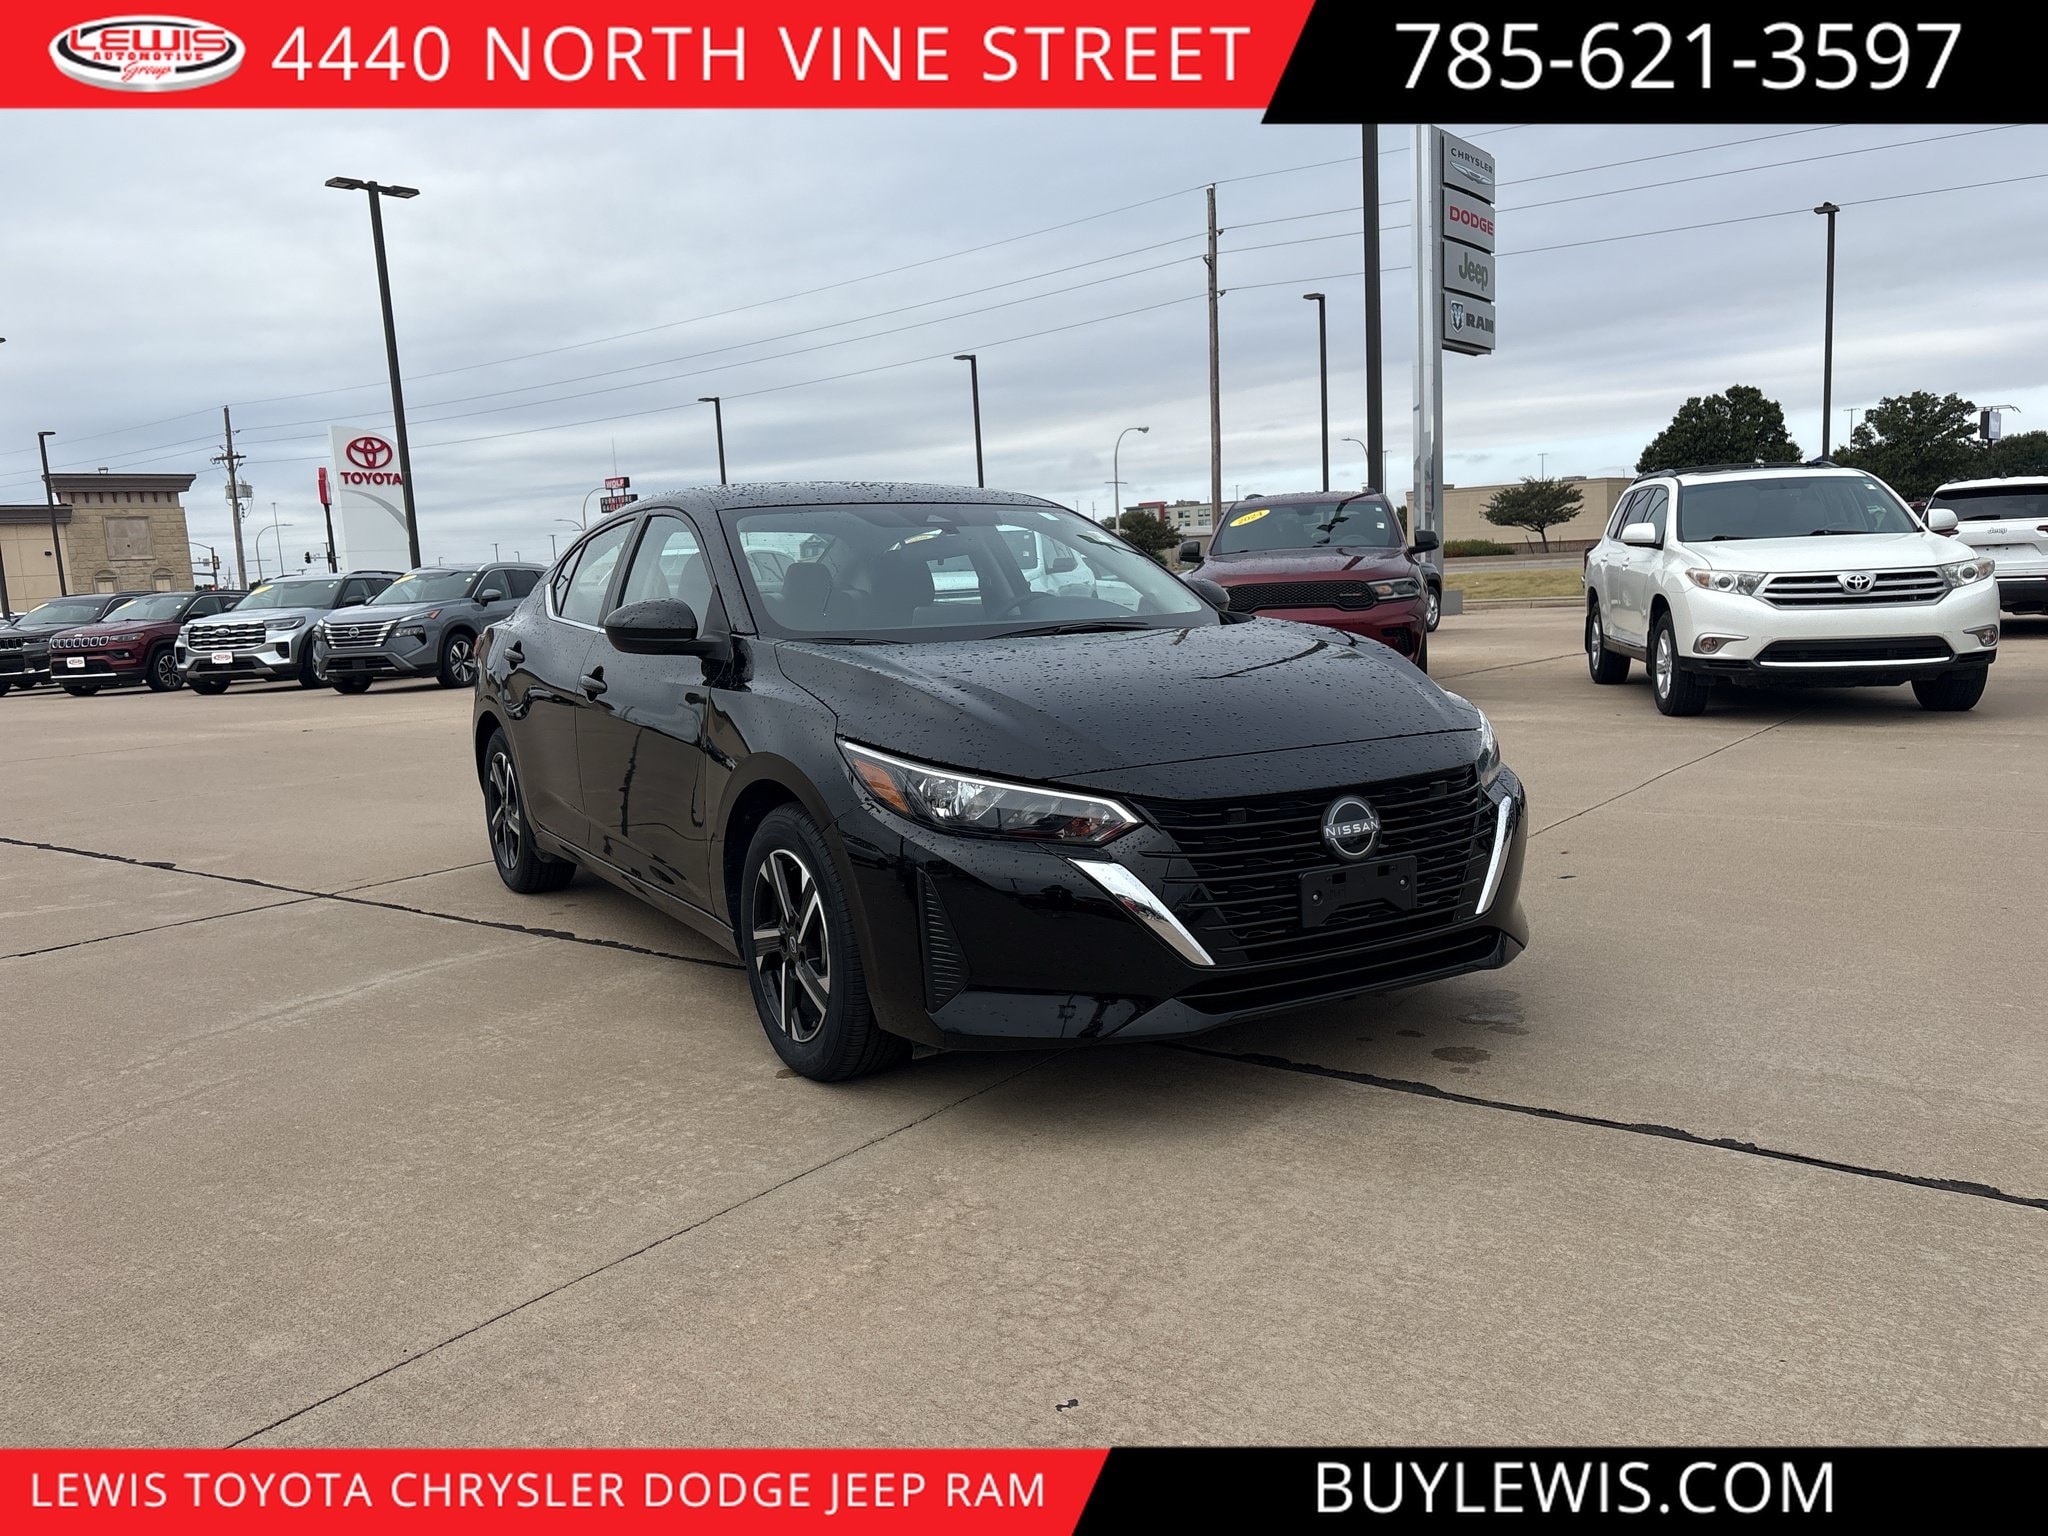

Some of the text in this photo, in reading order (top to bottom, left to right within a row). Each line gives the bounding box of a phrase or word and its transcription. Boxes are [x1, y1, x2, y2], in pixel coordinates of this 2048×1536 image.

[1450, 148, 1493, 174] CHRYSLER
[1449, 205, 1494, 236] DODGE
[1458, 252, 1489, 291] Jeep
[1466, 312, 1494, 334] RAM
[340, 472, 404, 485] TOYOTA
[1325, 820, 1378, 836] NISSAN
